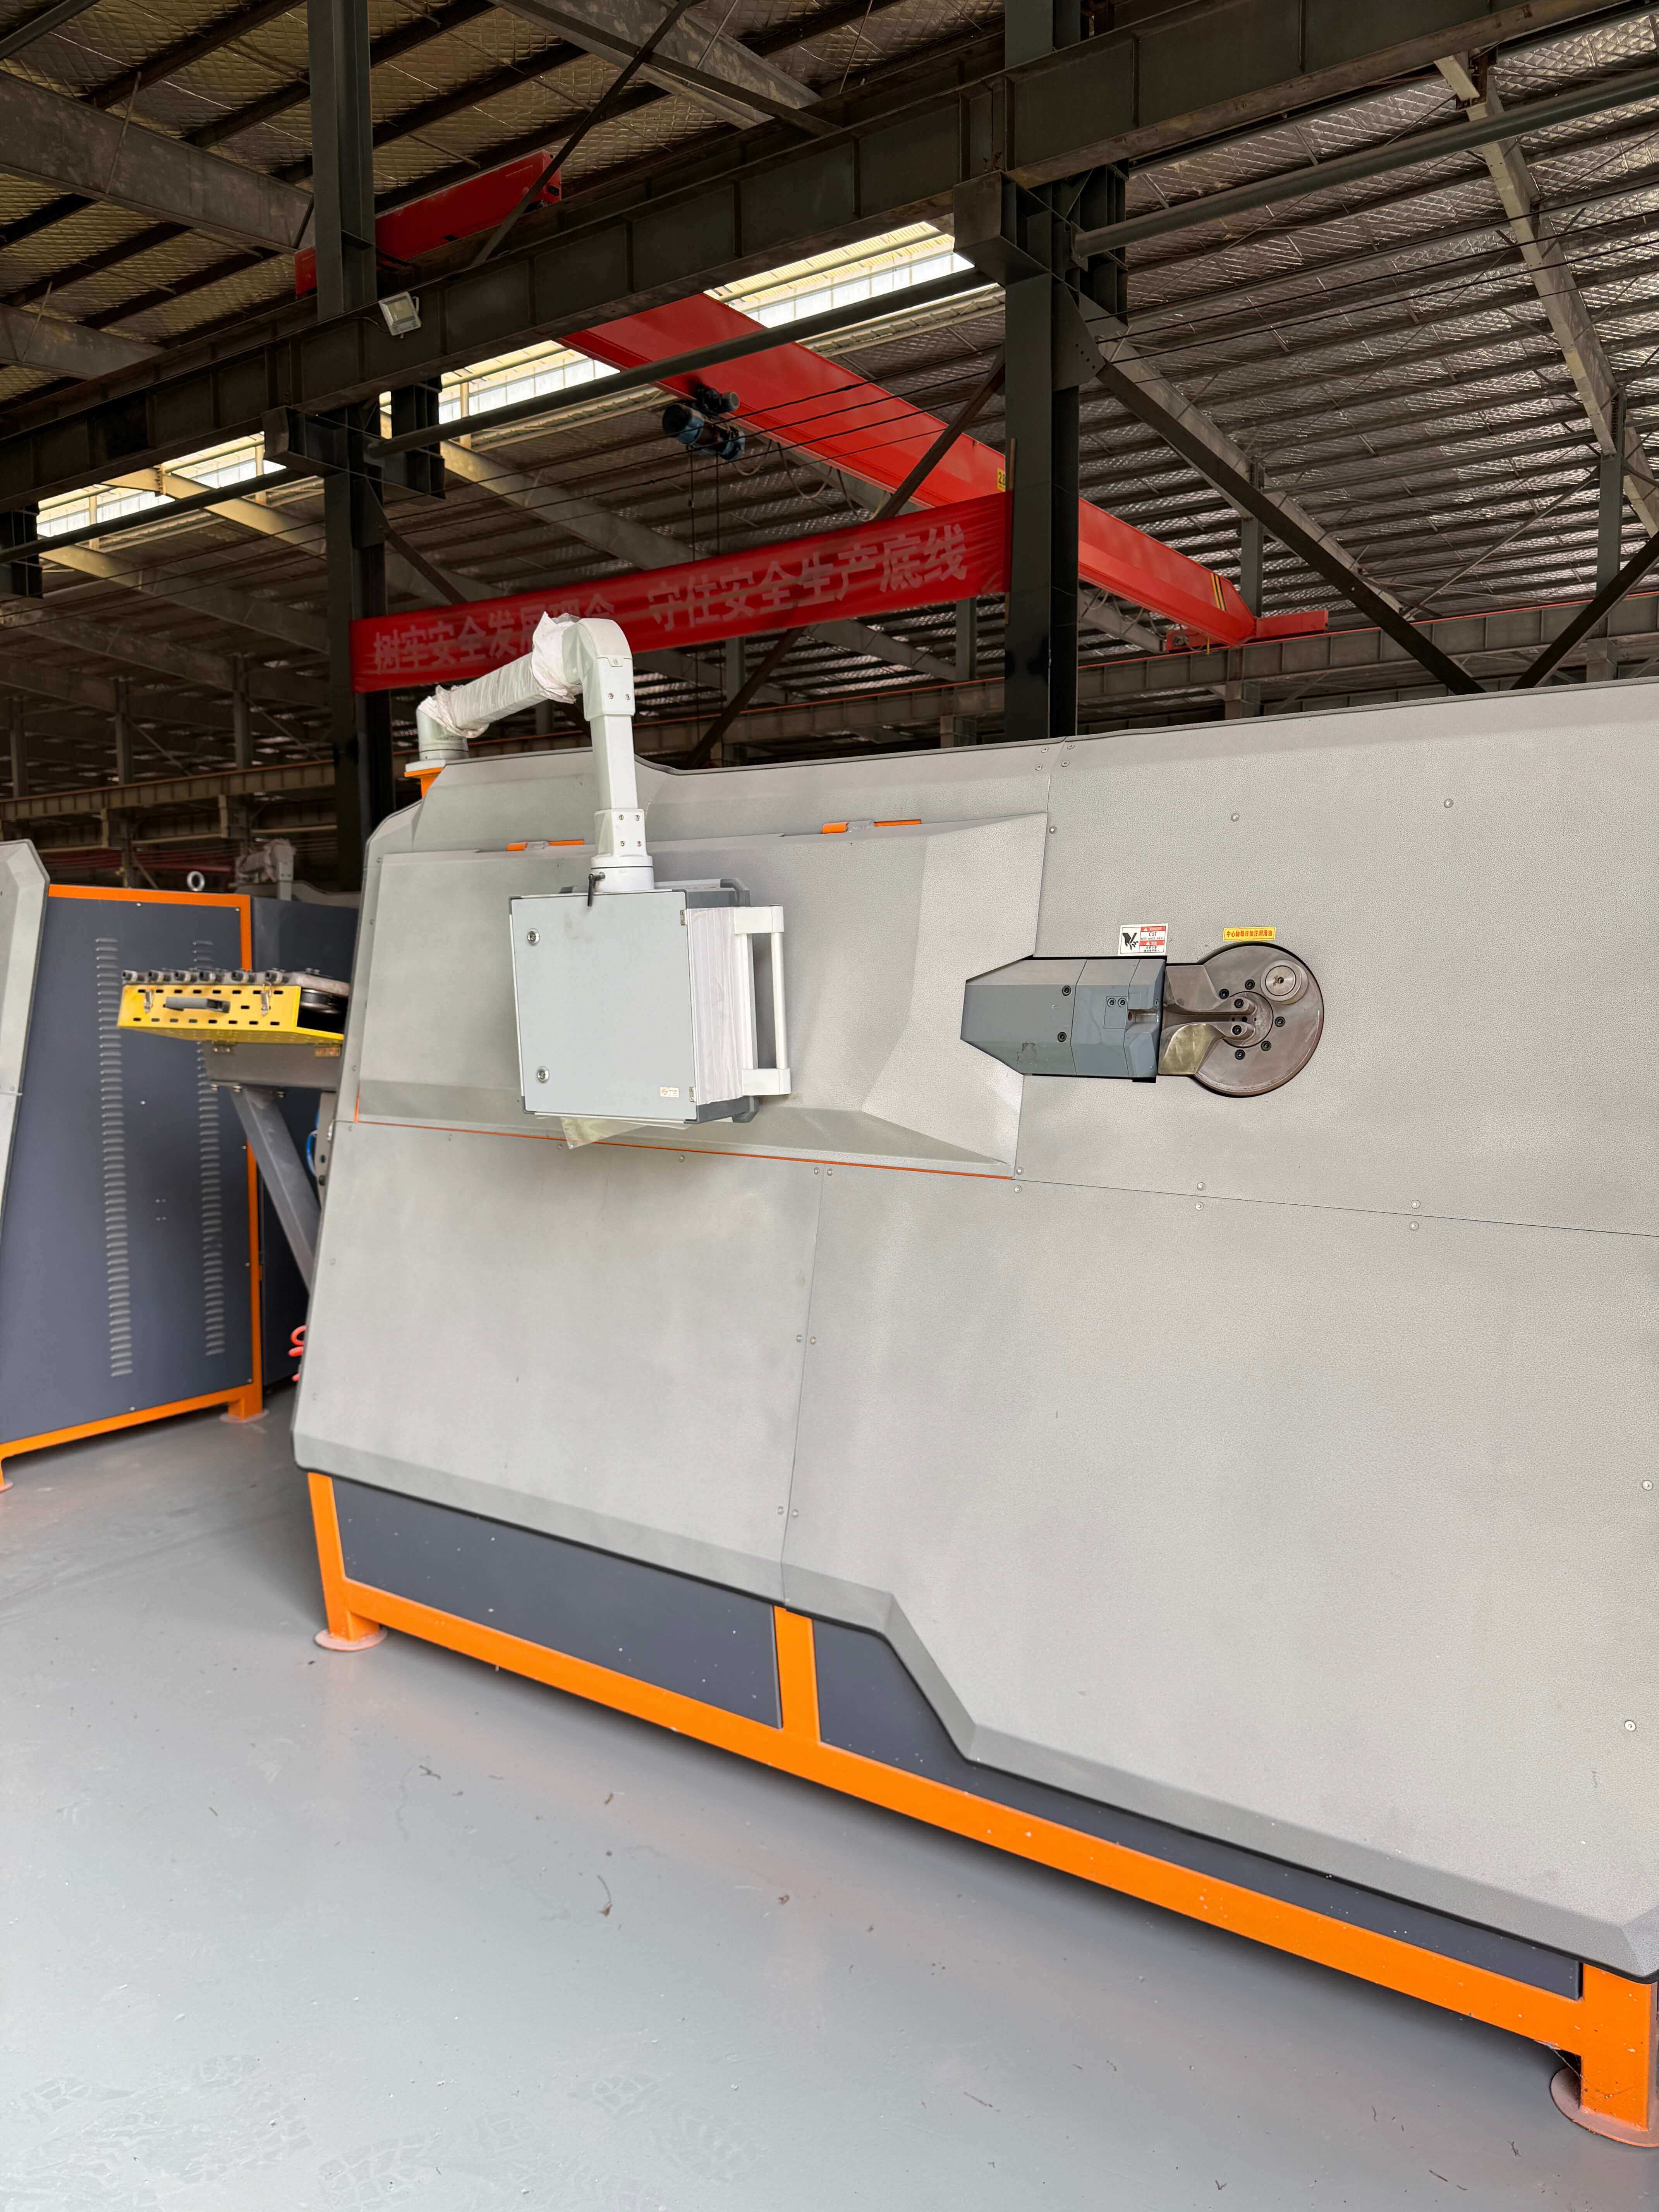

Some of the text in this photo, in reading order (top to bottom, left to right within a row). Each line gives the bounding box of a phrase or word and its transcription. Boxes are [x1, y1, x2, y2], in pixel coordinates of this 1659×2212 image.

[646, 523, 966, 632] 守住安全生产底线
